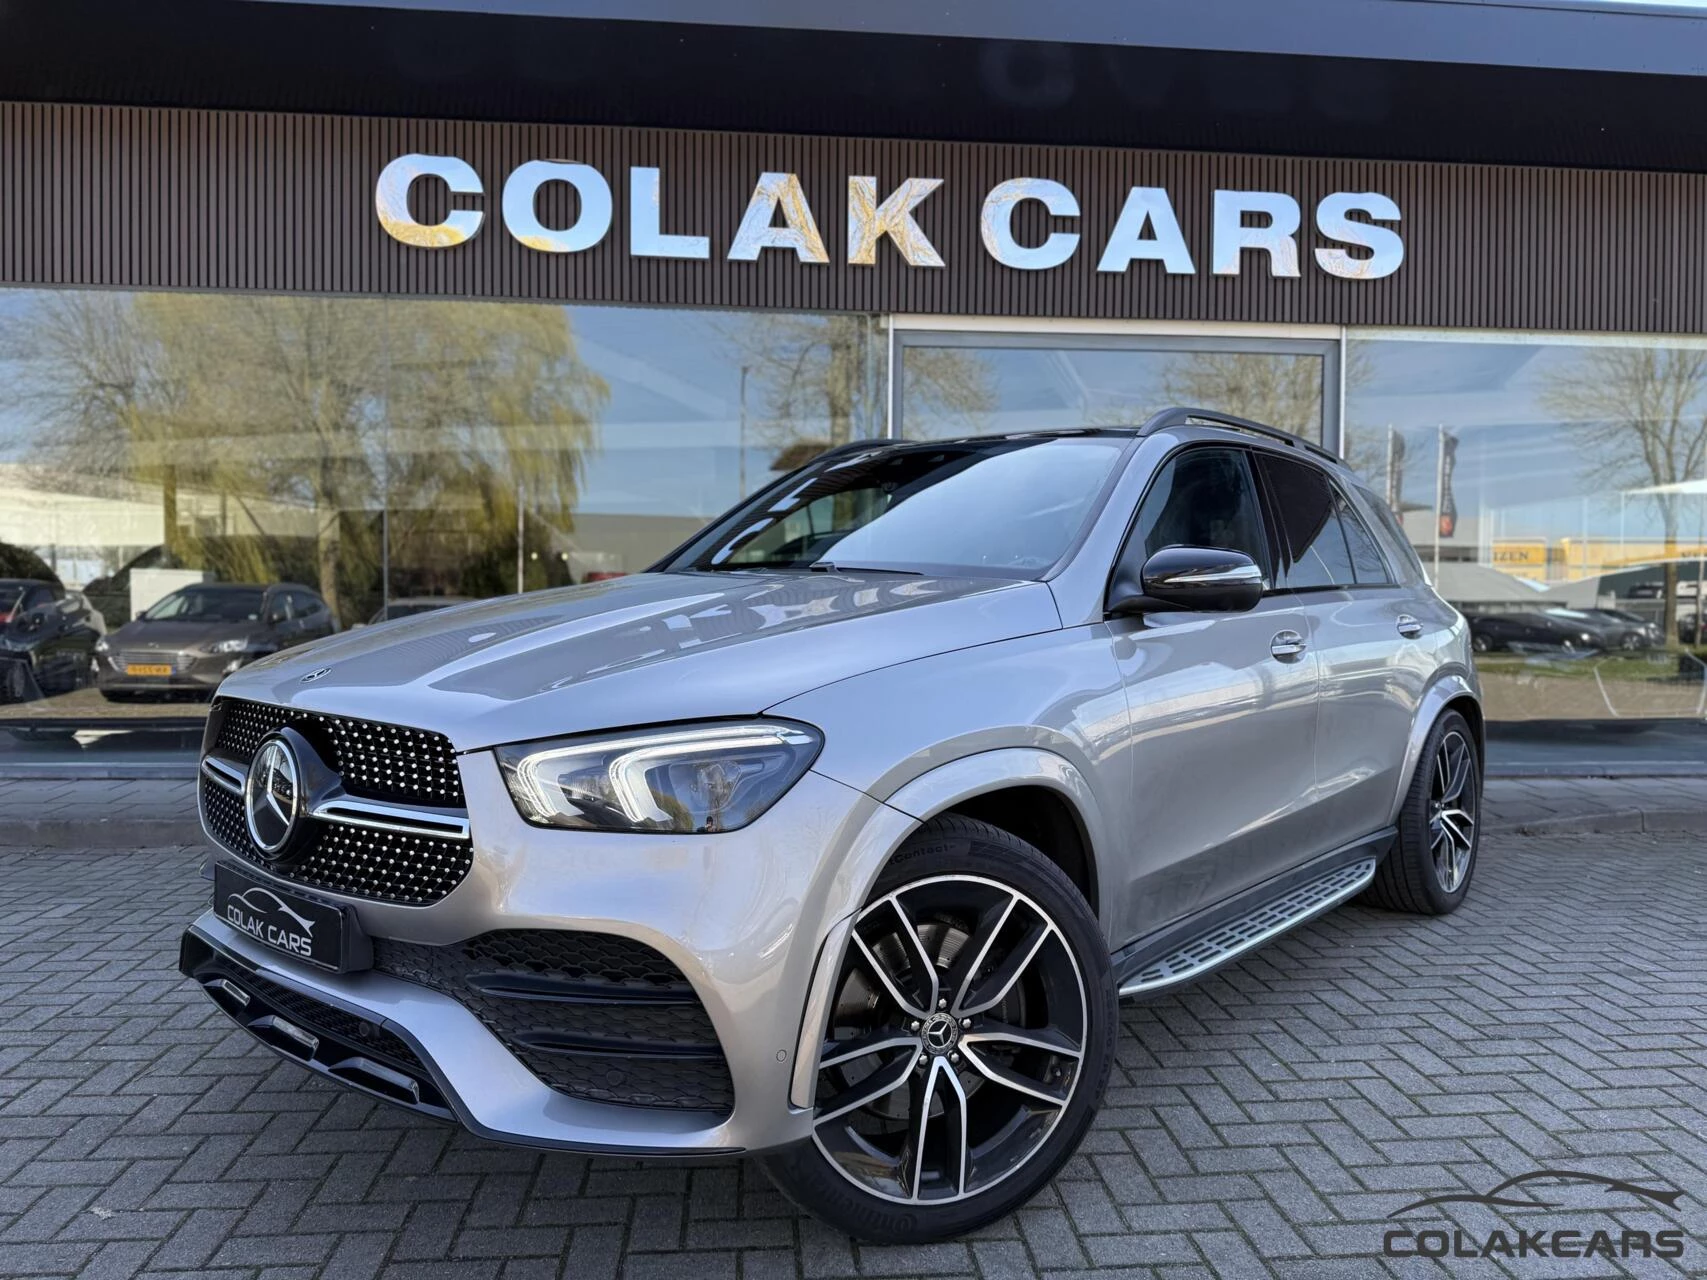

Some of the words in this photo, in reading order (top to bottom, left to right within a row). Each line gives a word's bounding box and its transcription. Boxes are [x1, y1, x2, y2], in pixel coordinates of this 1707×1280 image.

[375, 153, 946, 268] COLAK
[980, 176, 1405, 281] CARS
[227, 904, 264, 939] COLAK
[267, 925, 312, 957] CARS
